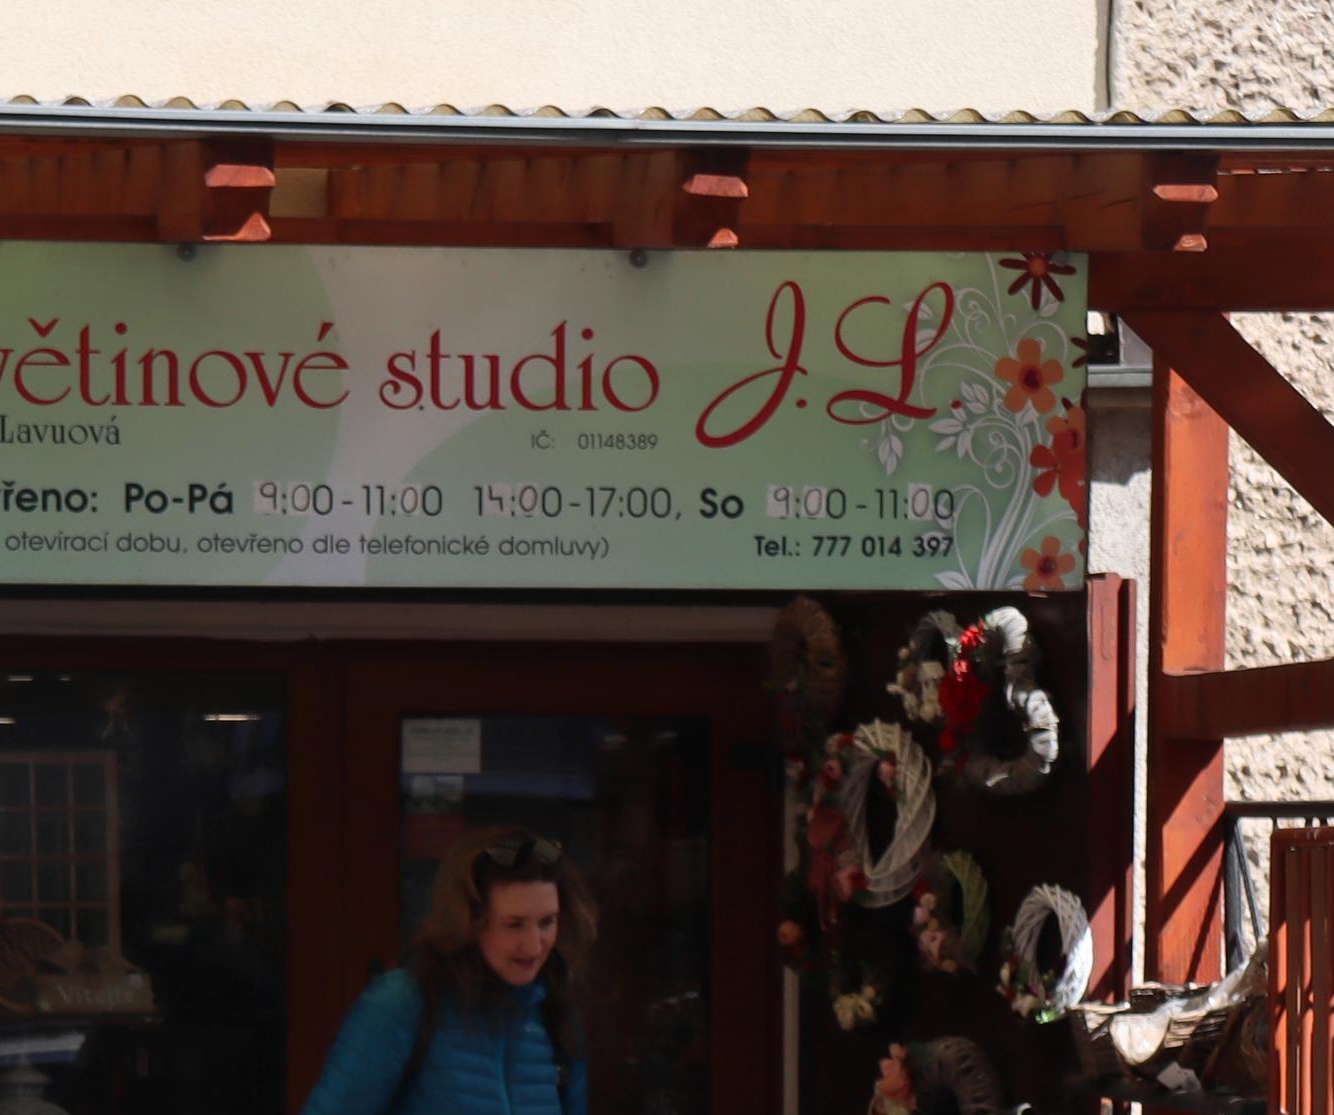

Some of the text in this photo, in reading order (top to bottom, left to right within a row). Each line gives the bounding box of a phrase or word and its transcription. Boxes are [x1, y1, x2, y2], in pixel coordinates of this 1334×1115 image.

[378, 320, 660, 412] studio
[530, 429, 659, 450] IČ: 01148389
[124, 482, 235, 515] Po-Pá
[699, 487, 745, 519] So
[4, 530, 109, 552] otevírací
[115, 531, 188, 555] dobu,
[197, 533, 304, 554] otevřeno
[312, 534, 351, 555] dle
[359, 534, 490, 556] telefonické
[498, 536, 610, 560] domluvy)
[754, 535, 955, 557] Tel.: 777 014 397
